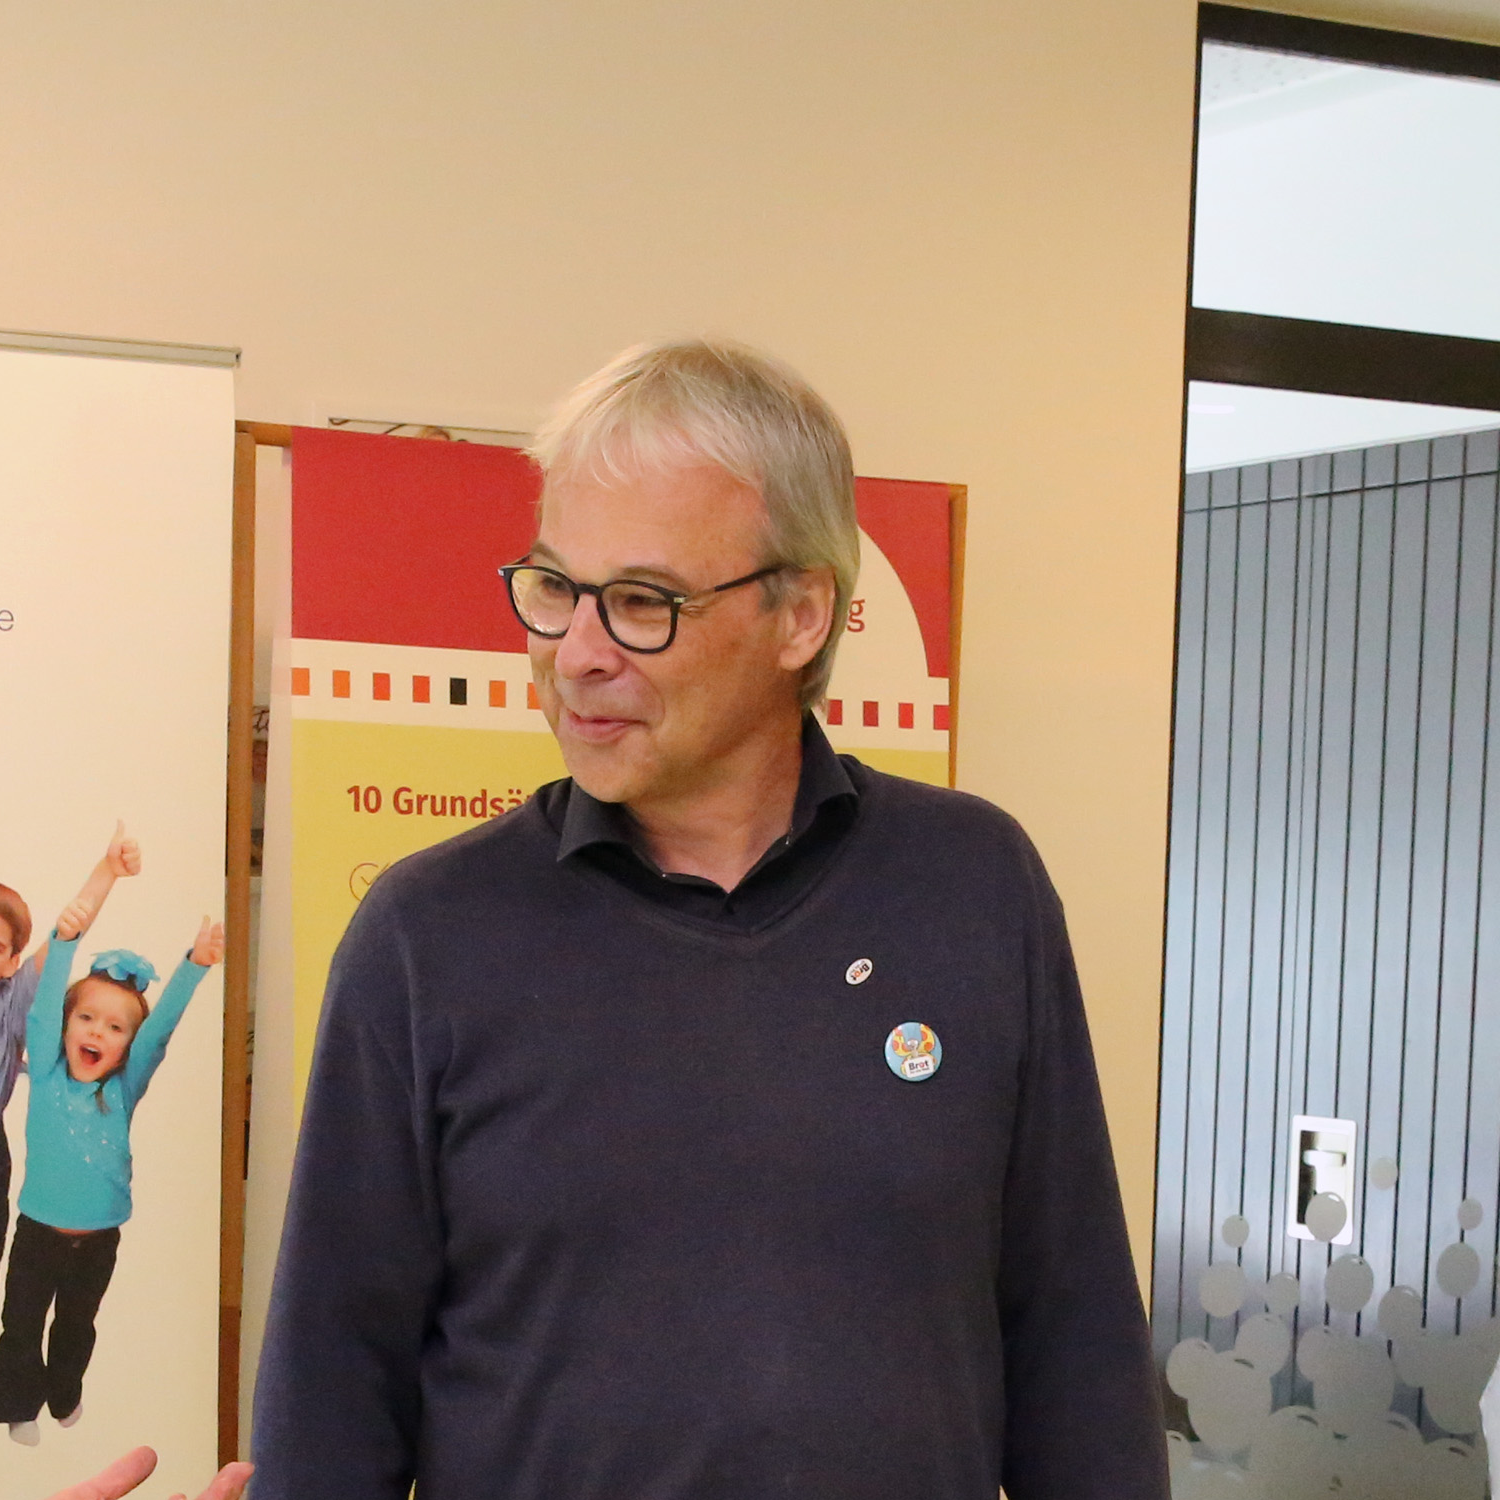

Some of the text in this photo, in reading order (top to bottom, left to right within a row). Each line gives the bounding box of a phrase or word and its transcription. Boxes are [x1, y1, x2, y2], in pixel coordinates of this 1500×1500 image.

[347, 785, 533, 819] 10 Grundsä
[908, 1060, 930, 1072] Brot
